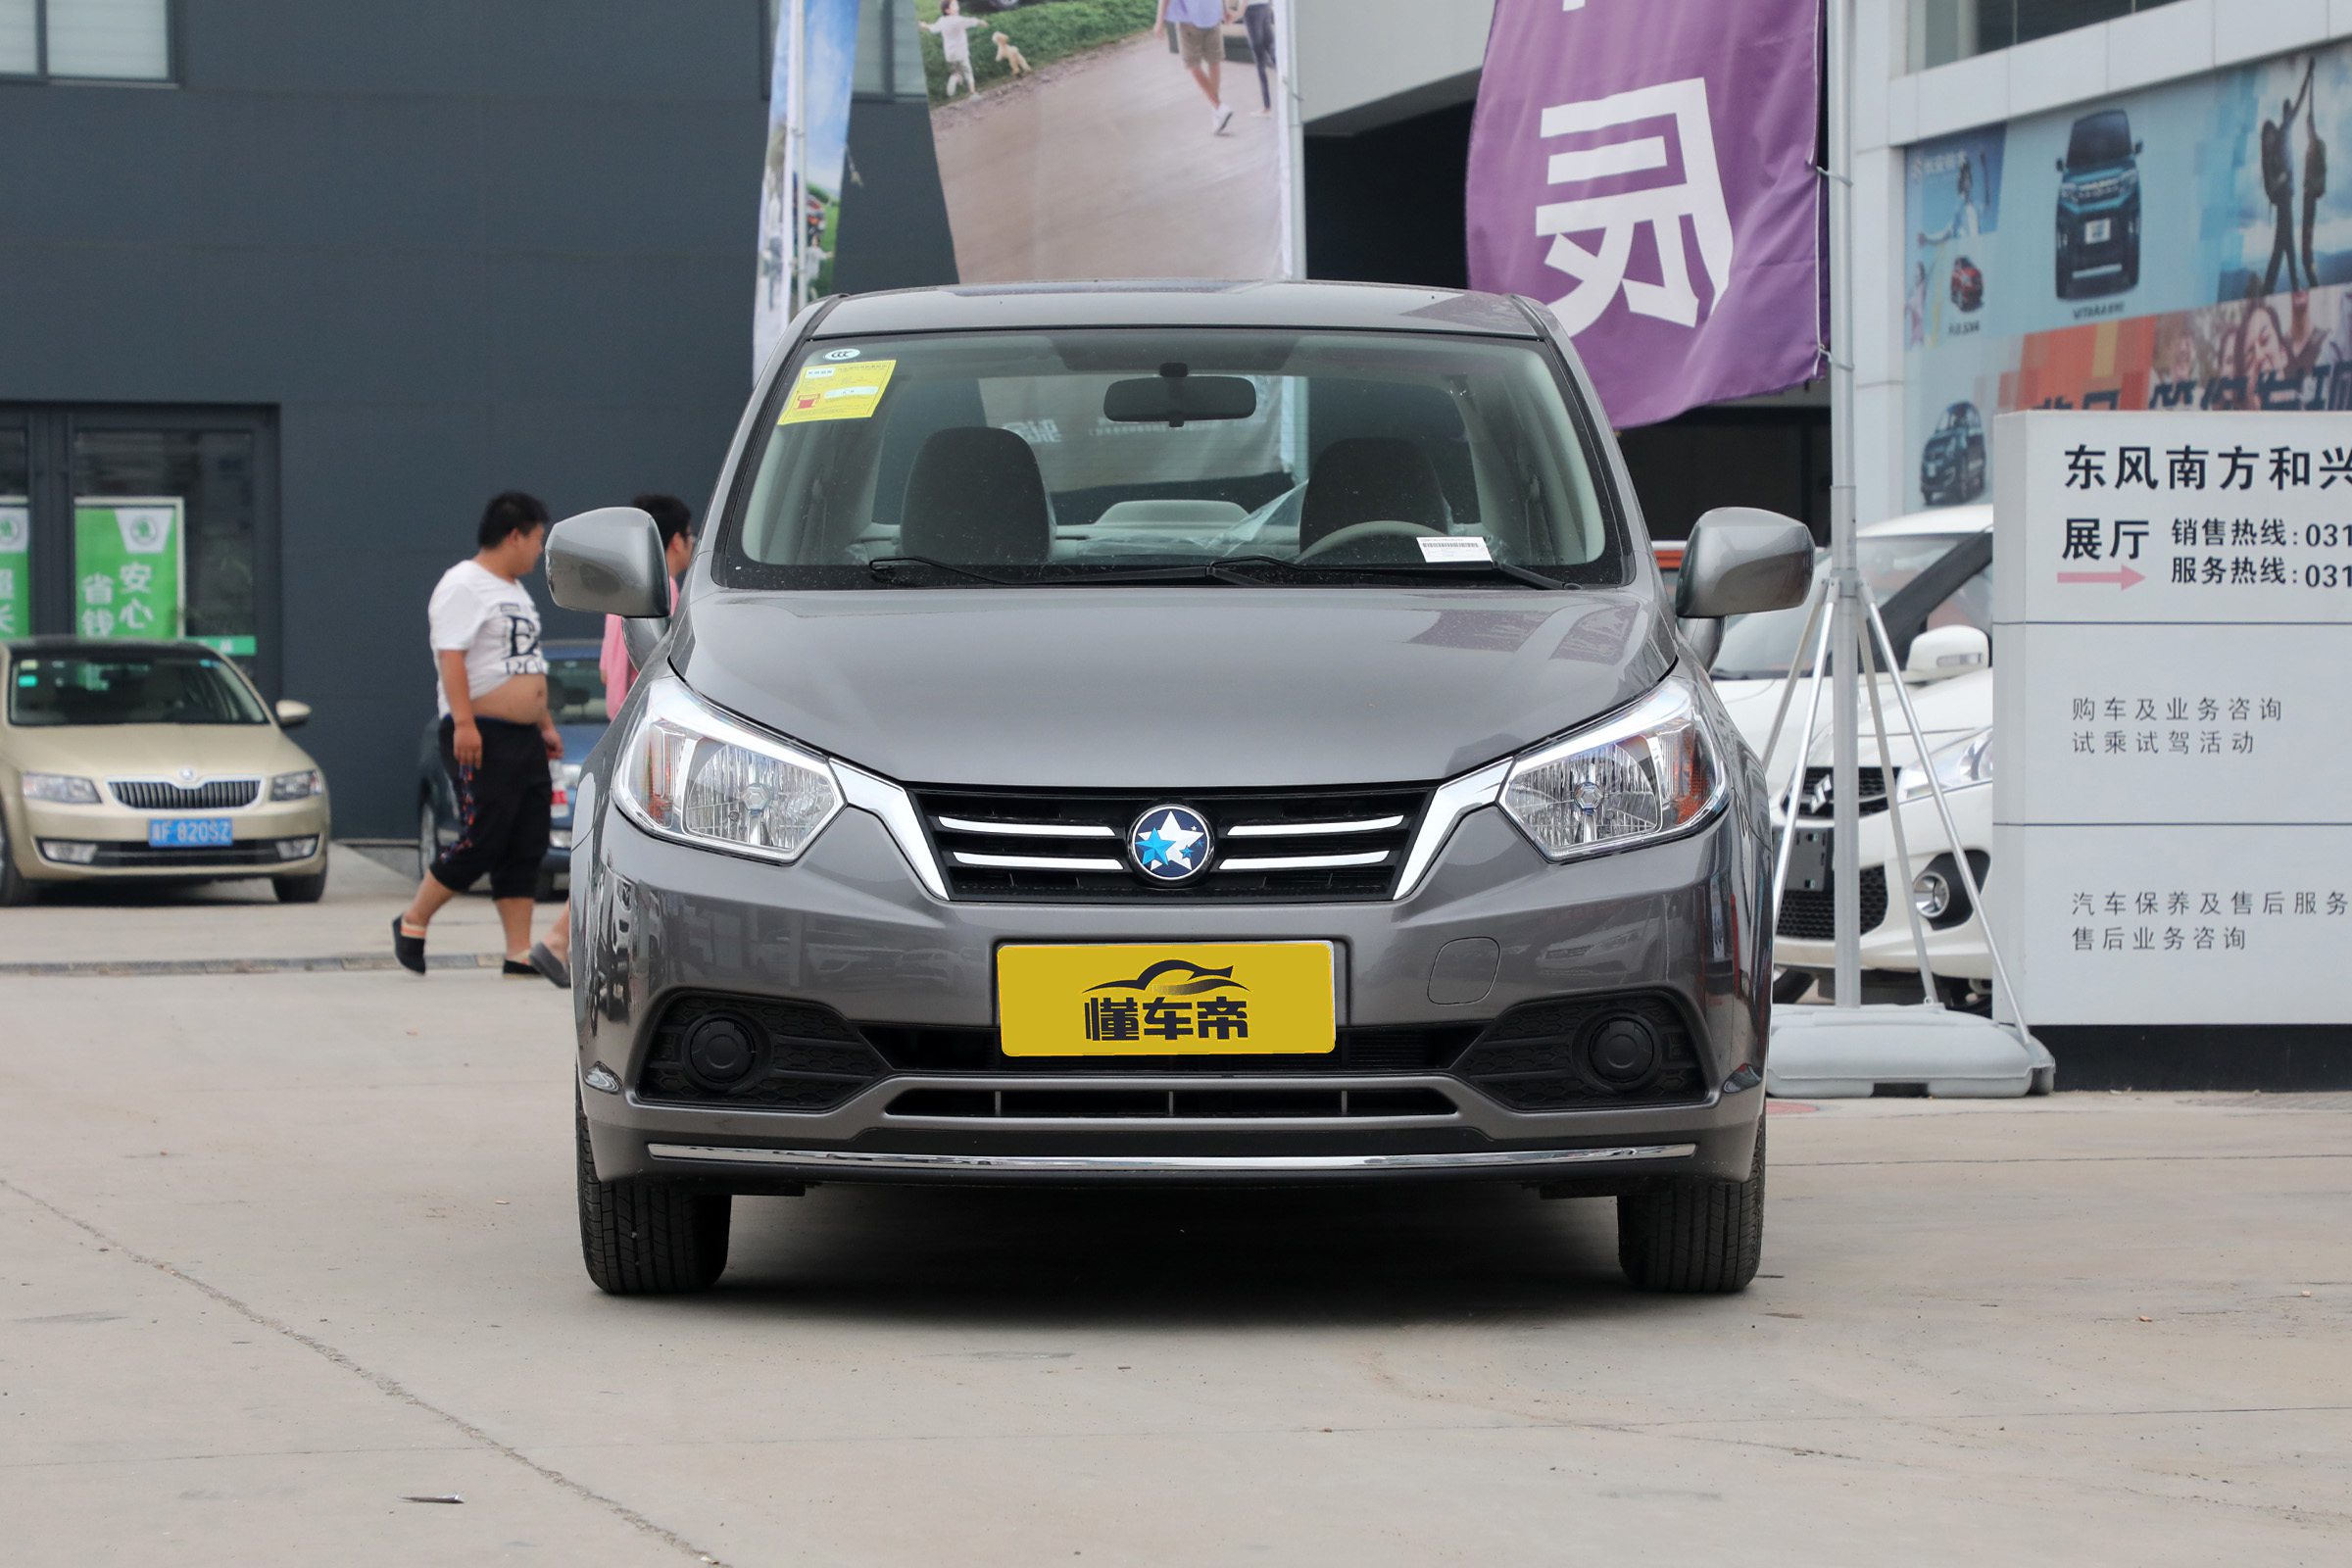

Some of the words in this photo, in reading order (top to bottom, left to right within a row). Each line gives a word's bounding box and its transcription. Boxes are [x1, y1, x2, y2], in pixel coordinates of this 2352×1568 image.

[1536, 0, 1734, 338] 辰
[2064, 444, 2352, 490] 东风南方和兴
[2062, 517, 2149, 560] 展厅
[2073, 697, 2281, 721] 购车及业务咨询
[2073, 730, 2253, 755] 试乘试驾活动
[2072, 891, 2349, 916] 汽车保养及售后服务
[2072, 926, 2246, 952] 售后业务咨询
